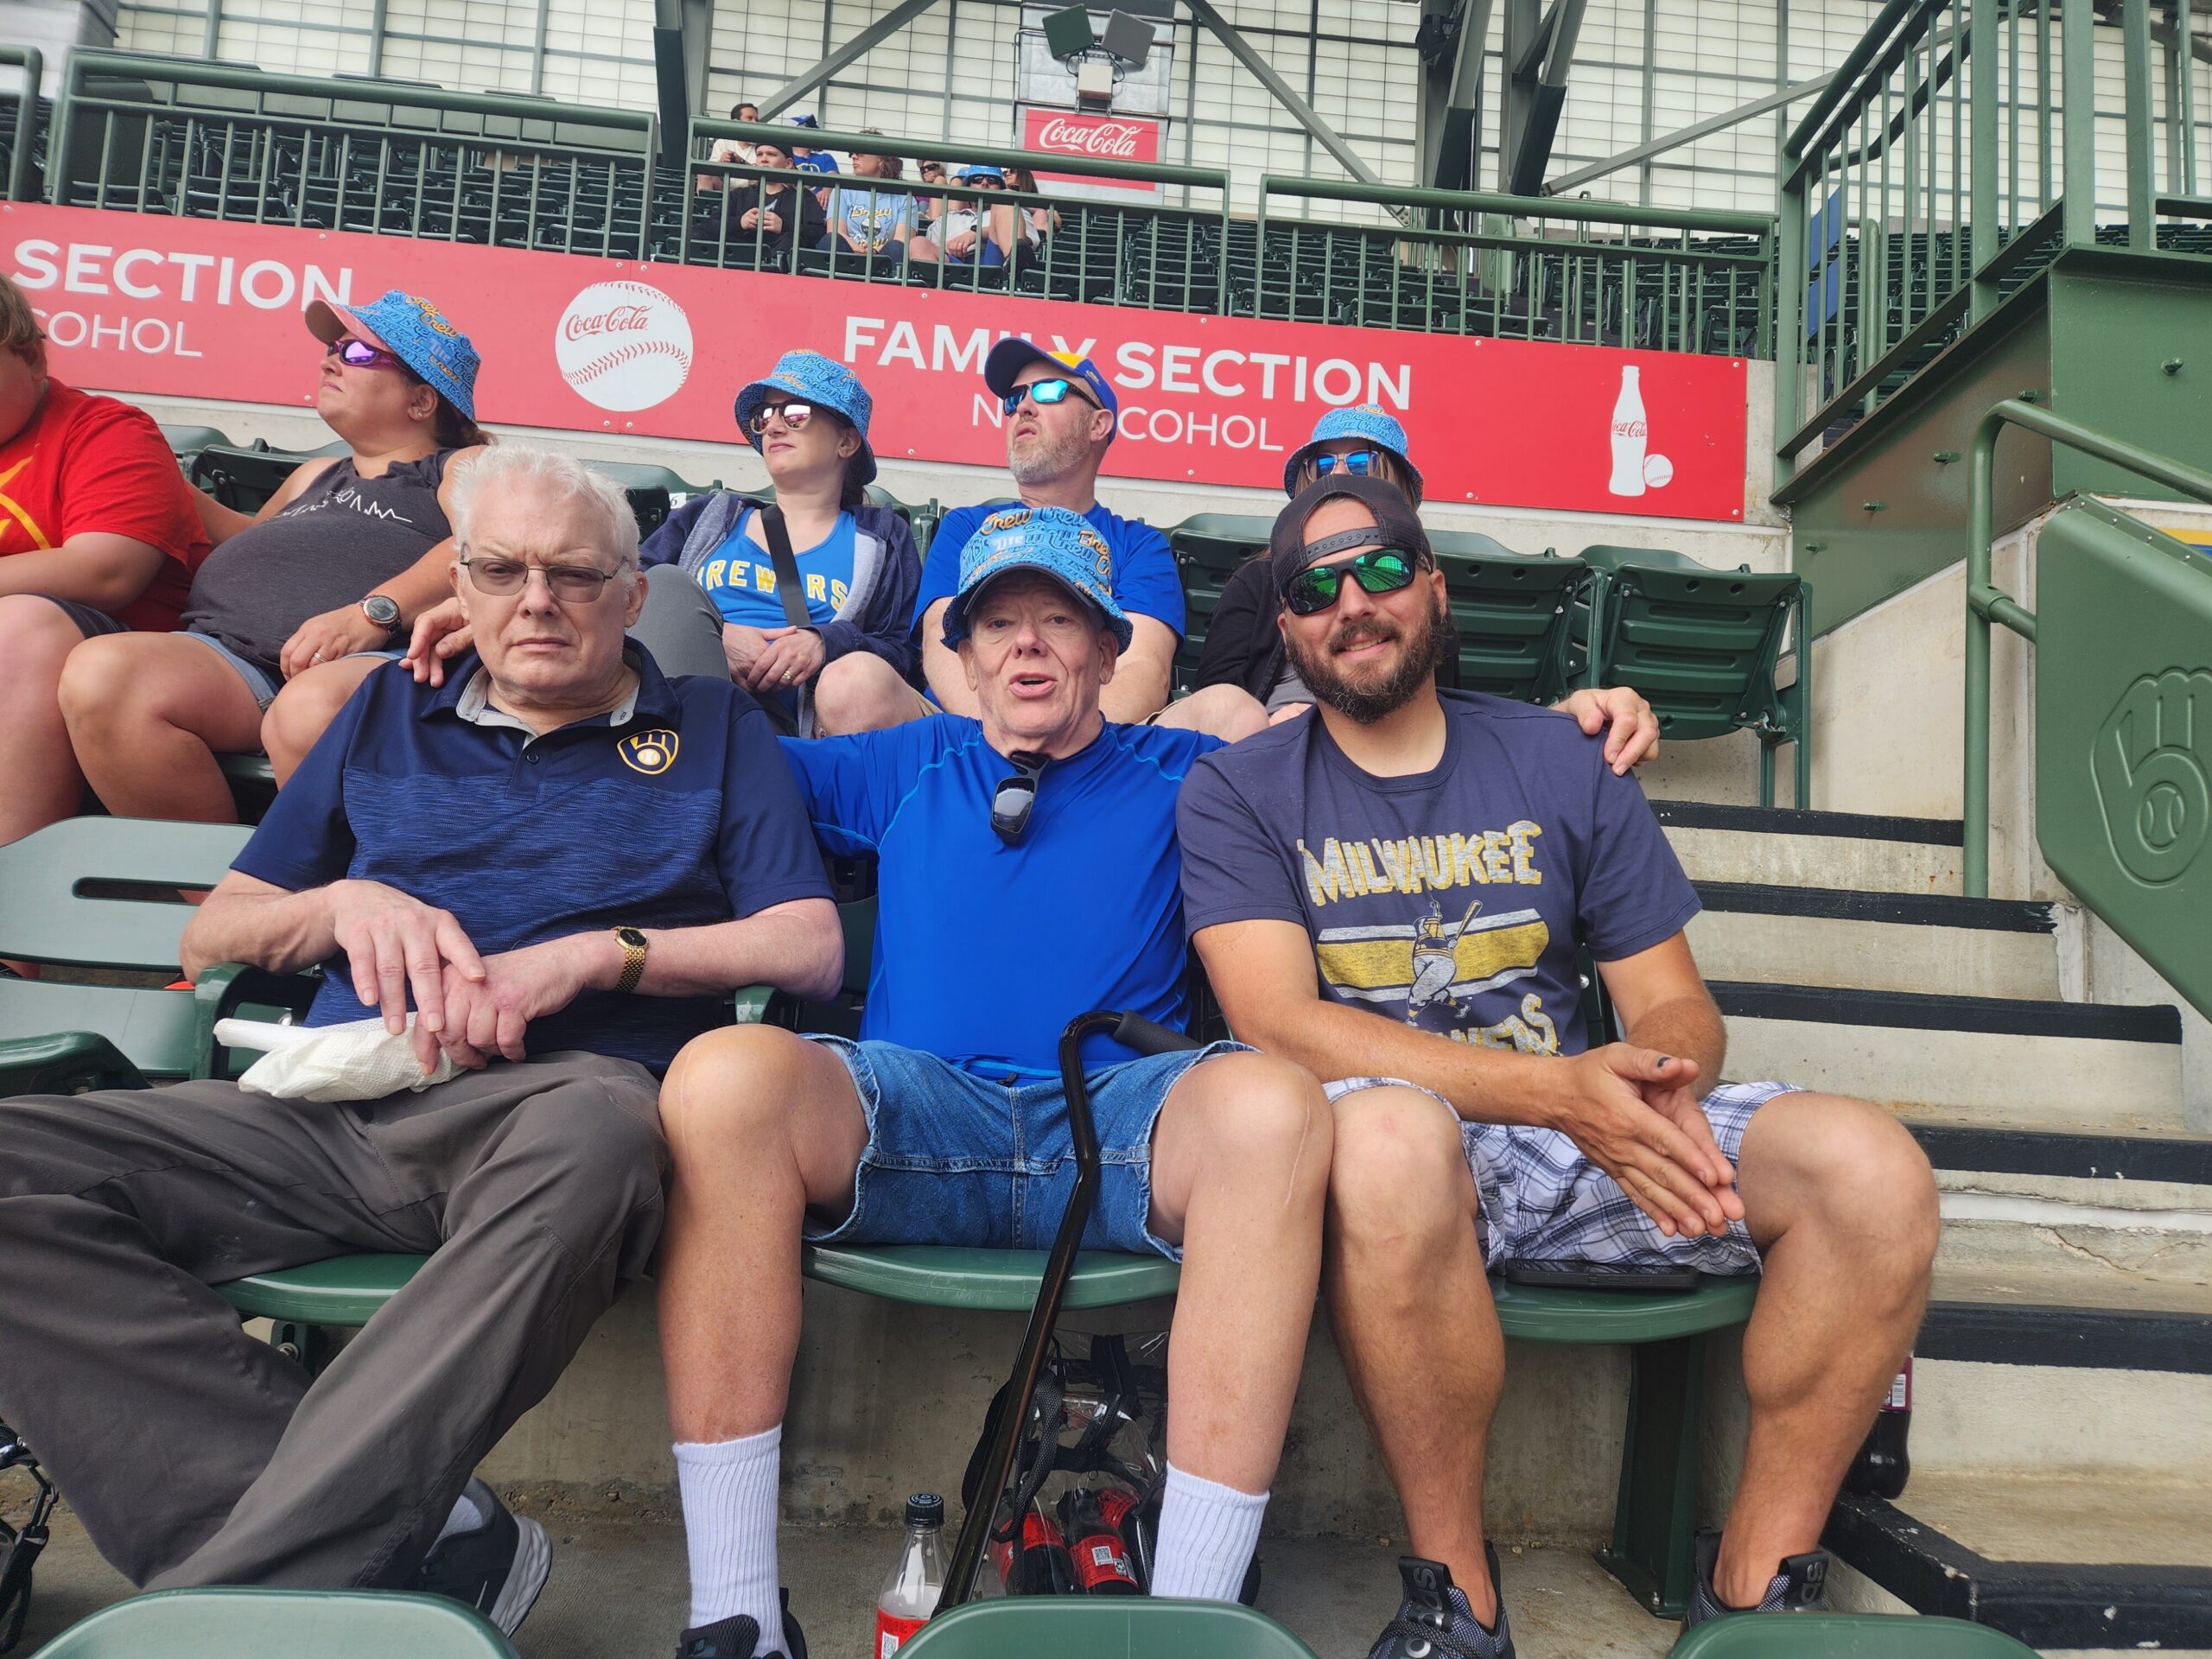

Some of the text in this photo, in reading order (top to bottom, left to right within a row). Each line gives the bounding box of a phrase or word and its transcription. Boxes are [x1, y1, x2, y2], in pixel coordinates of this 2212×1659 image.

[1039, 118, 1143, 156] Coca-Cola
[12, 238, 353, 311] SECTION
[32, 307, 203, 358] OHOL
[565, 305, 654, 341] Coca-Cola
[843, 315, 1411, 410] FAMY SECTION
[1117, 406, 1284, 452] COHOL
[980, 509, 1033, 536] Crew
[696, 559, 849, 612] REWRS
[1297, 819, 1544, 907] MILWAUKEE
